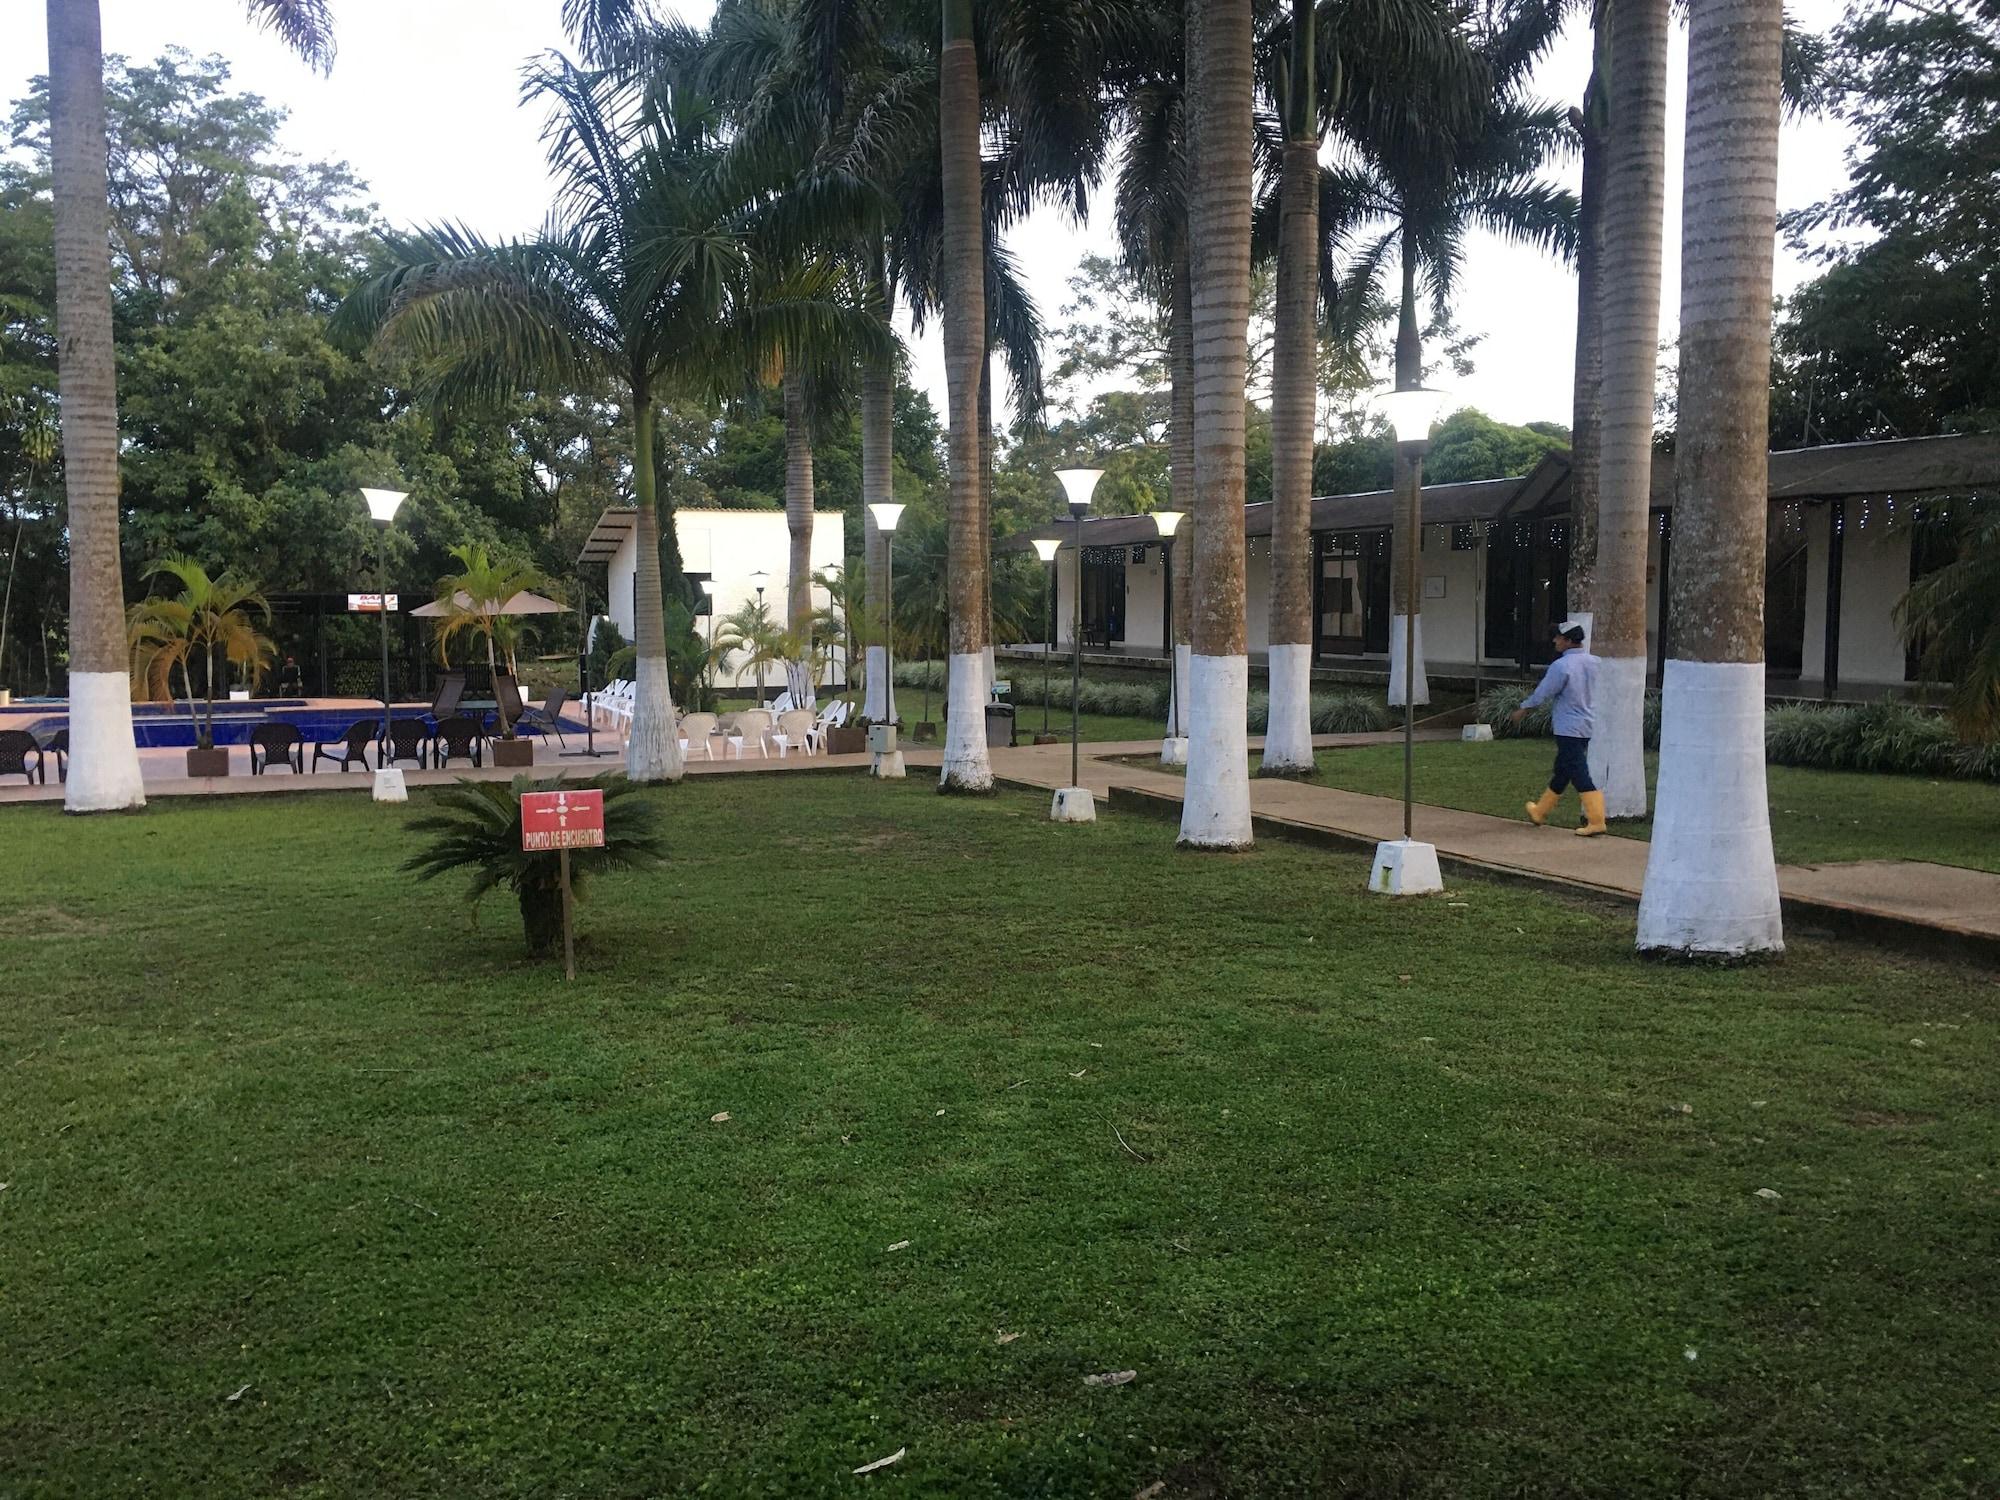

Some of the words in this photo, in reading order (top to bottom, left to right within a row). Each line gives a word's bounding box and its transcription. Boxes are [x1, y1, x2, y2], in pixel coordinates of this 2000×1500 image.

[525, 831, 550, 848] PUNTO
[550, 830, 561, 846] DE
[561, 828, 603, 846] ENCUENTRO
